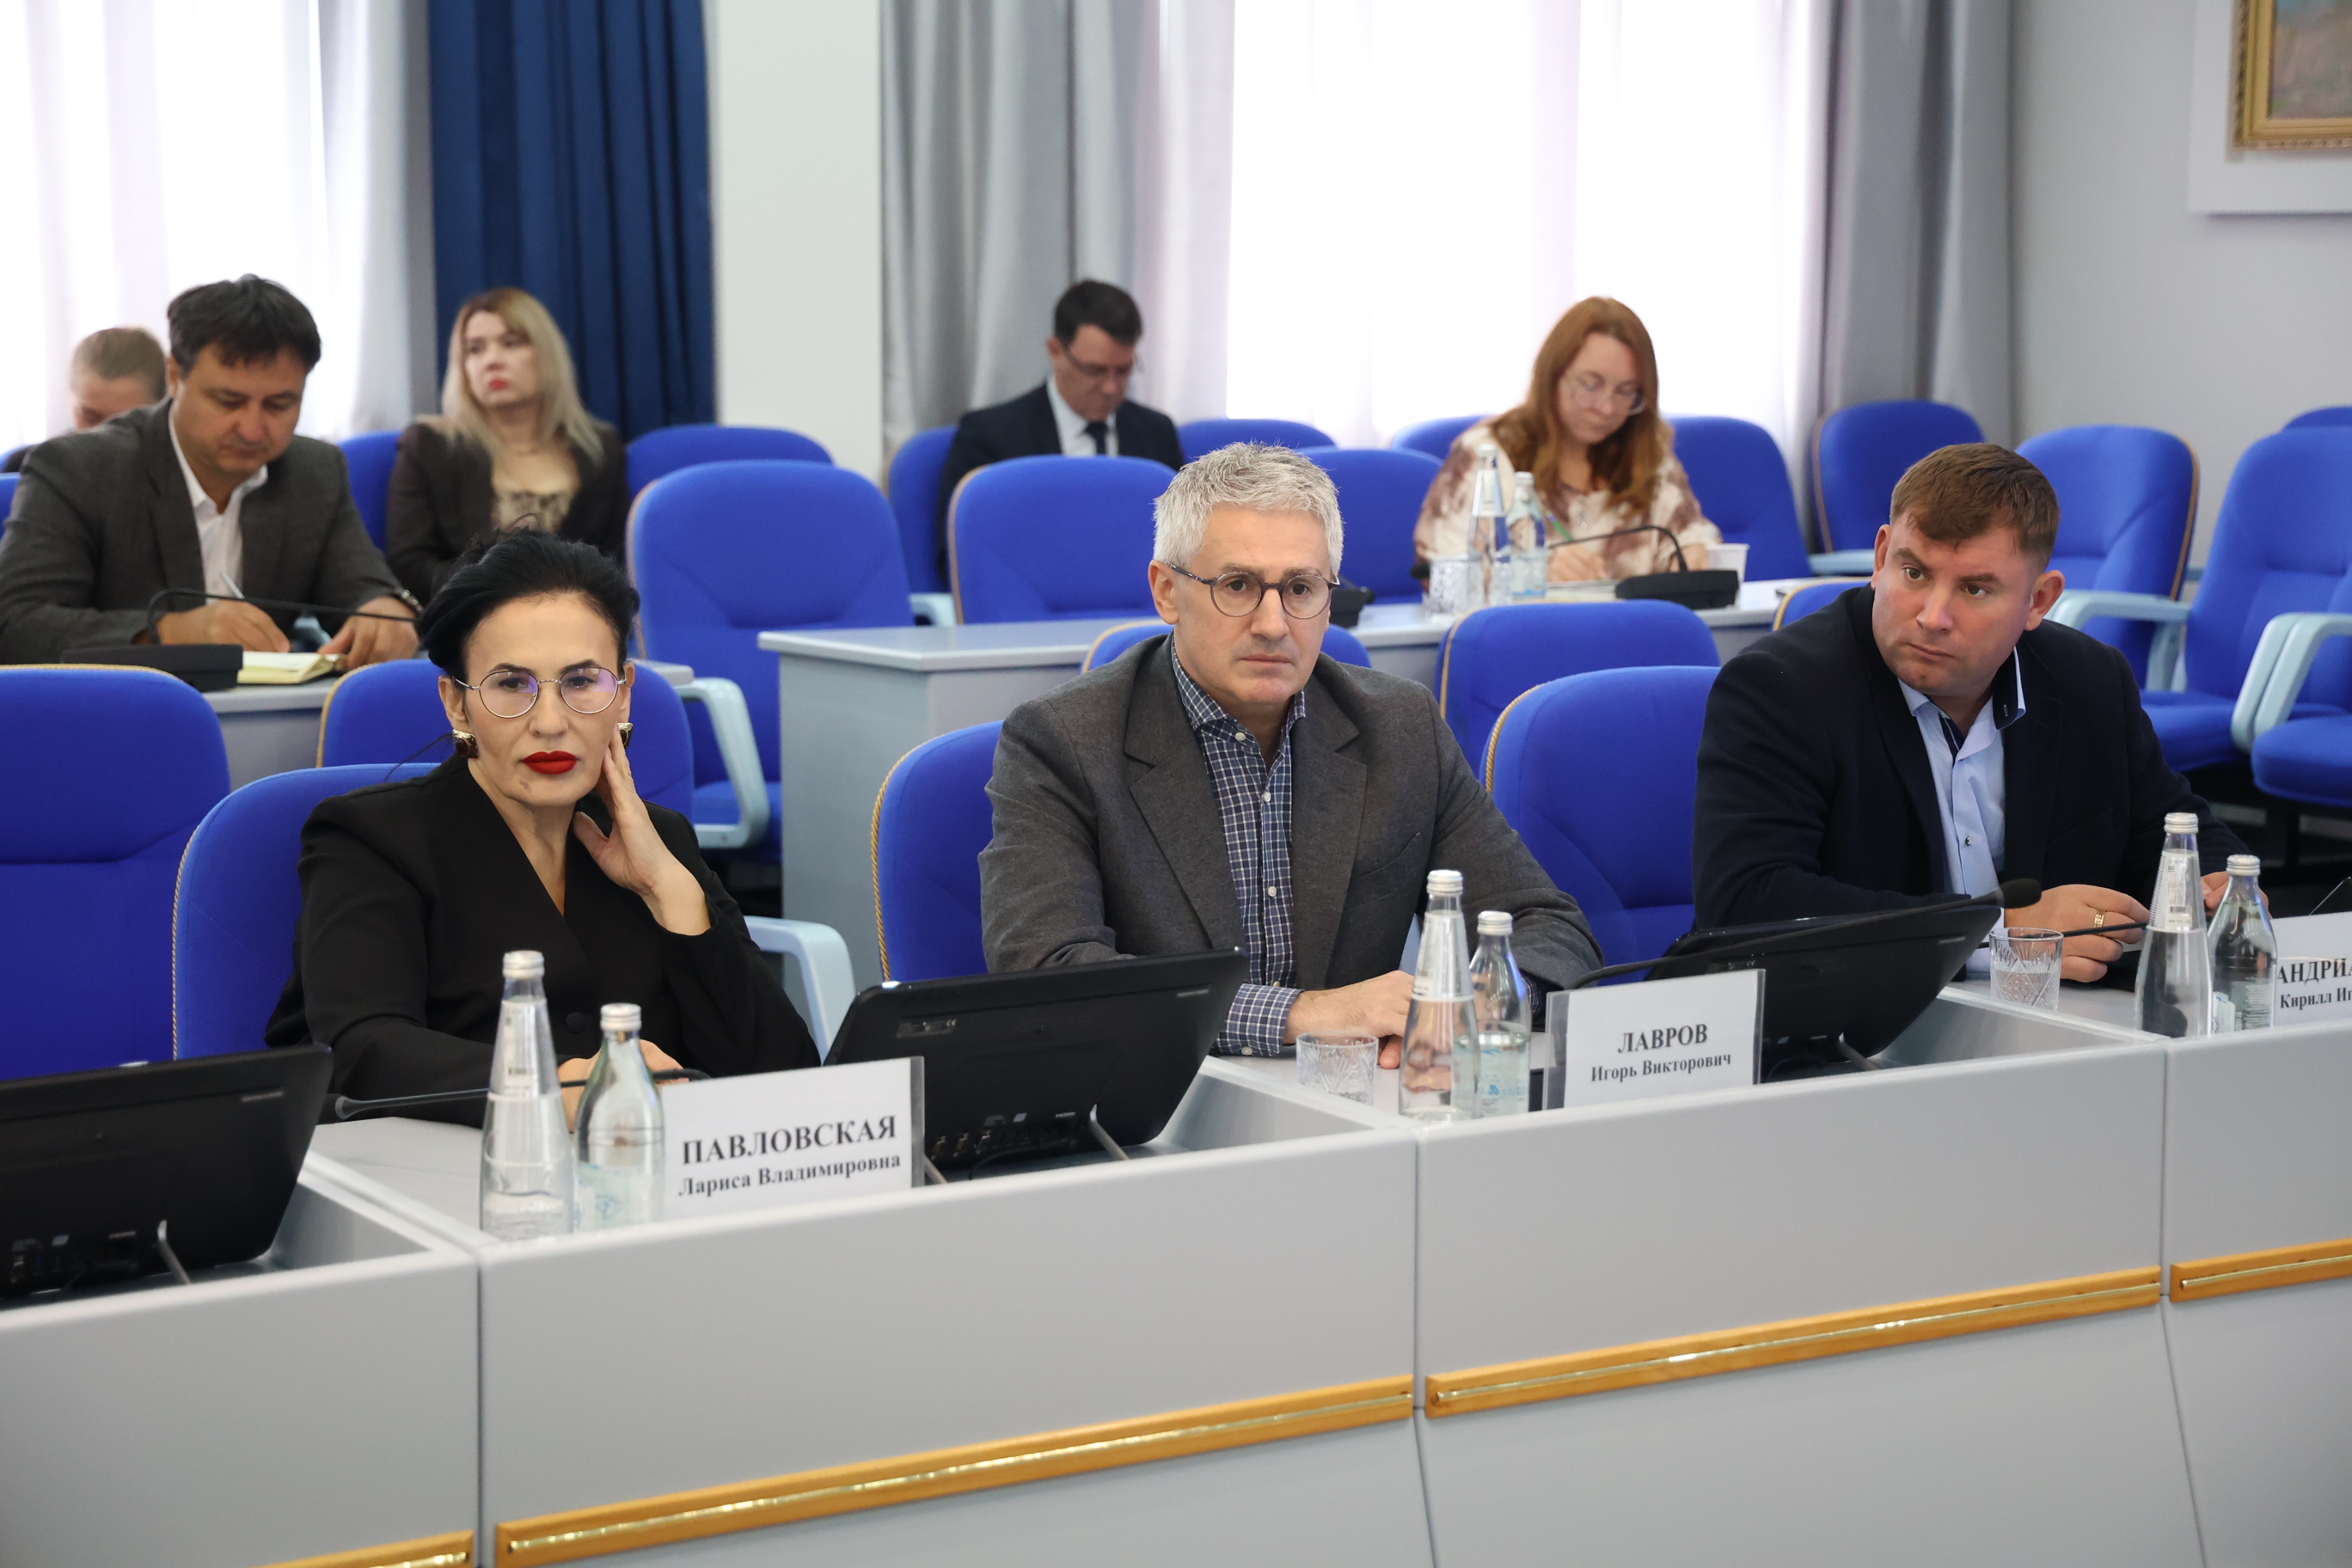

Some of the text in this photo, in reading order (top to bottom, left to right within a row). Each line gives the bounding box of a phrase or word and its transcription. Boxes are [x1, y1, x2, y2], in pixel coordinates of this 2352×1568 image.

[2280, 993, 2332, 1011] Кирилл
[1617, 1024, 1708, 1053] ЛАВРОВ
[1591, 1054, 1731, 1083] Игорь Викторович
[682, 1115, 897, 1166] ПАВЛОВСКАЯ
[678, 1155, 901, 1197] Лариса Владимировна
